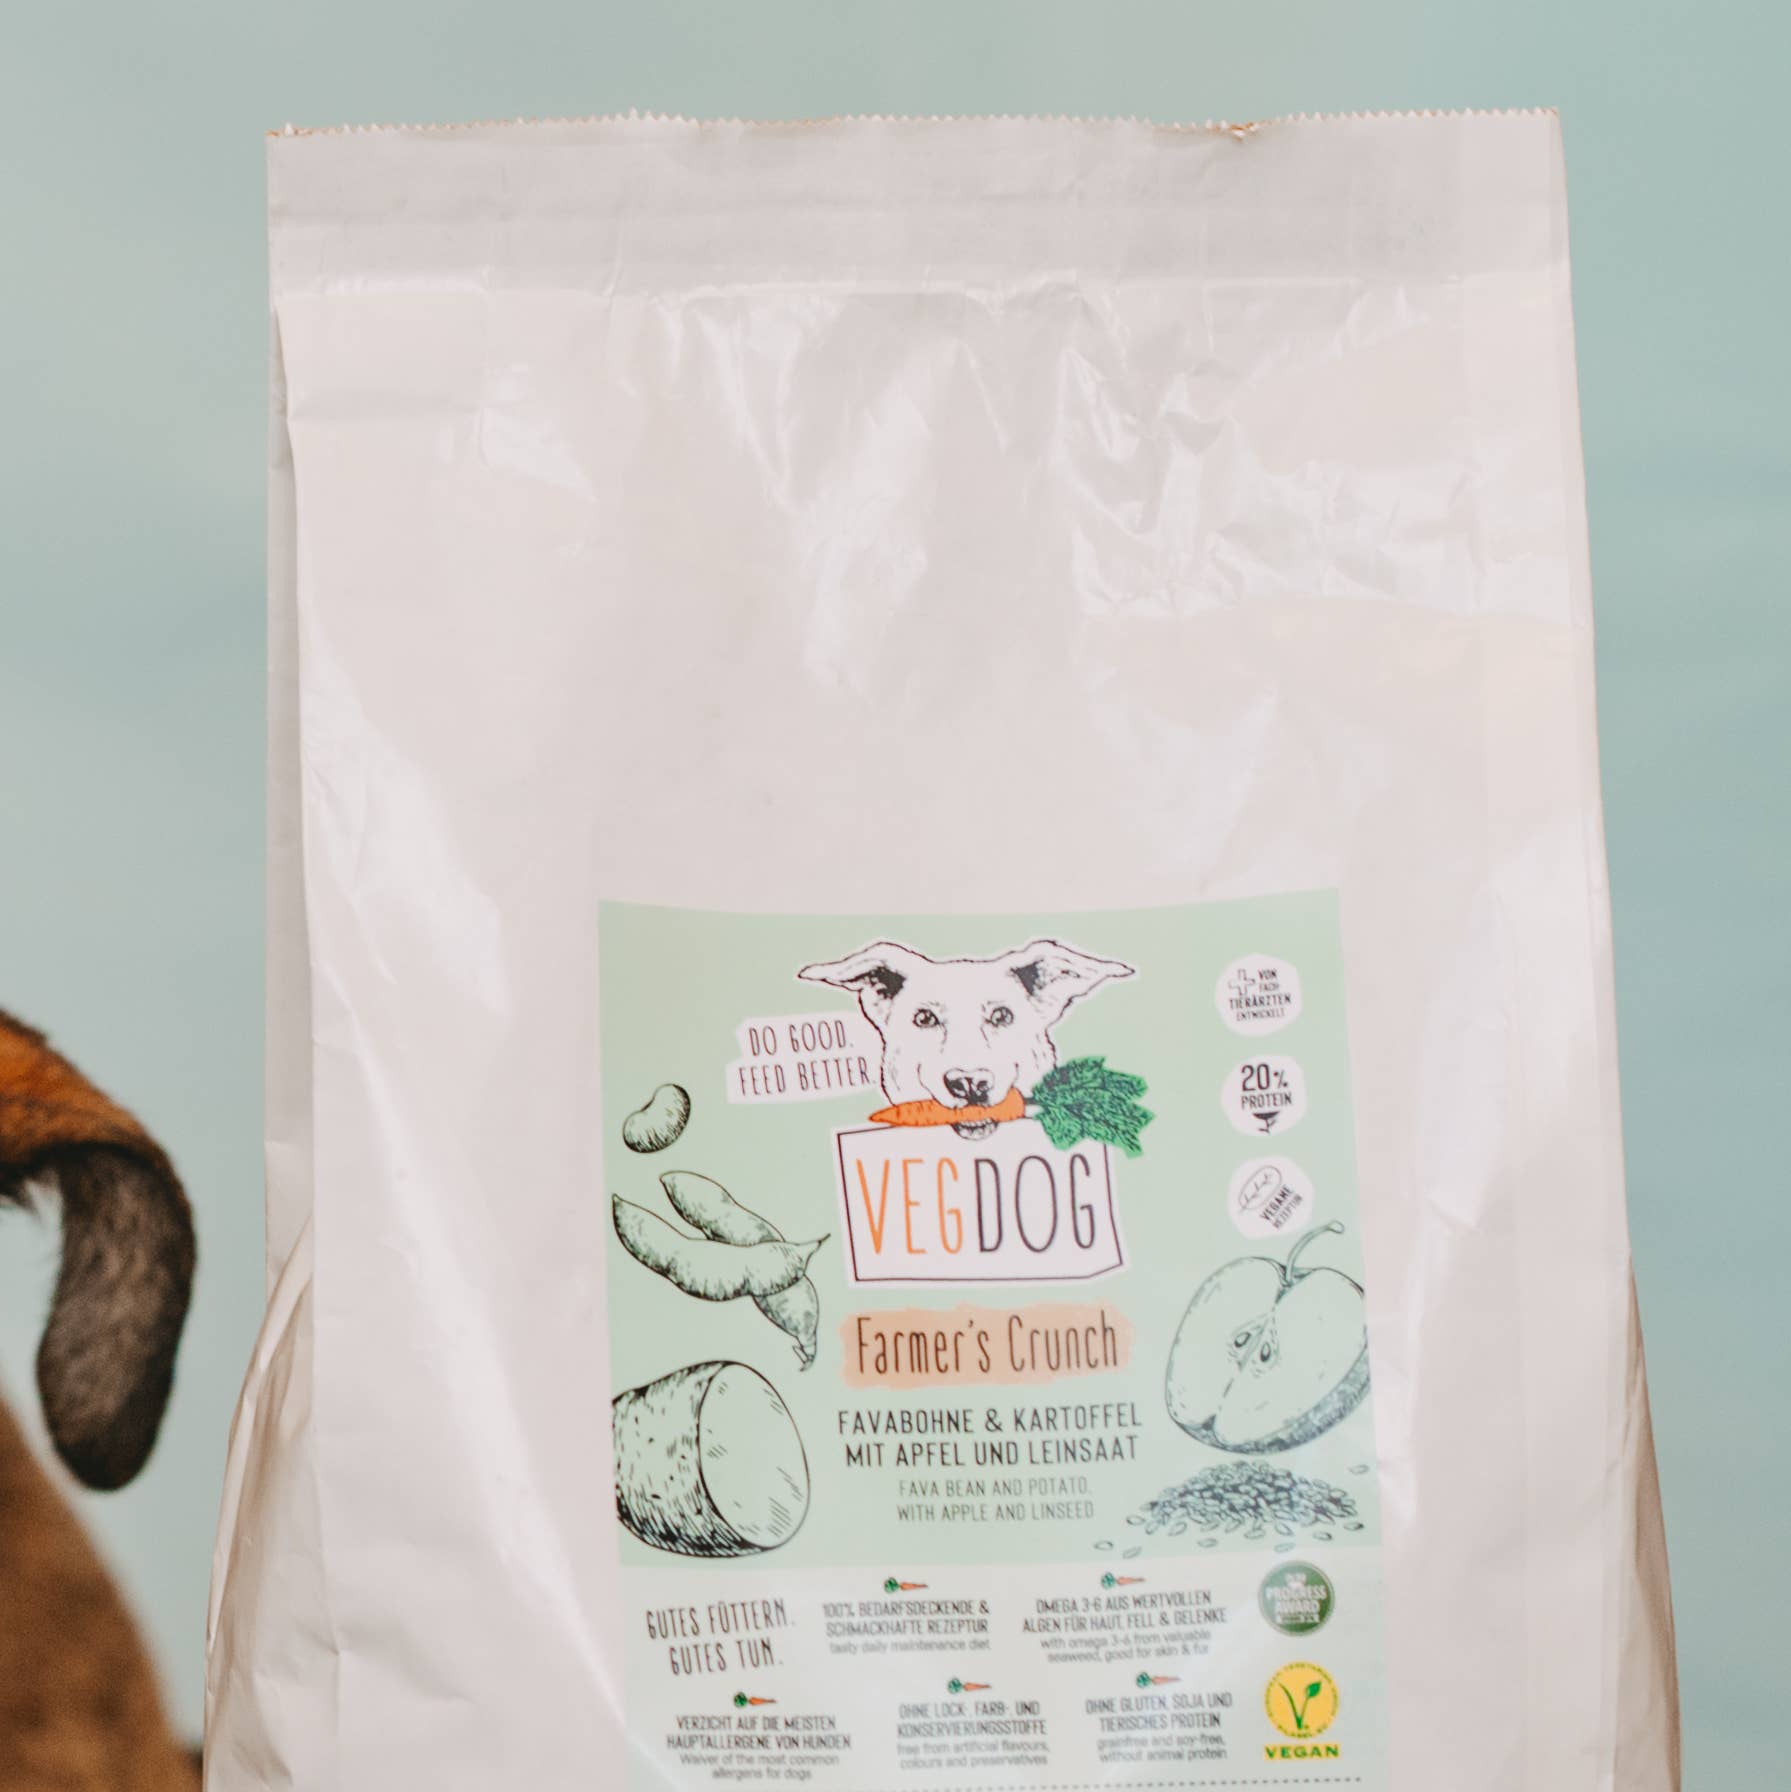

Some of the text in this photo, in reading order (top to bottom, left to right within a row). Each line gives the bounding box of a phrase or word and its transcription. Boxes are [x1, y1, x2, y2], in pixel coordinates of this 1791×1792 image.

[749, 1020, 855, 1056] DO GOOD.
[739, 1056, 876, 1096] FEED BETTER.
[1241, 1092, 1293, 1110] PROTEIN
[856, 1154, 1095, 1255] VEGDOG
[857, 1309, 1118, 1375] Farmer's Crunch
[837, 1402, 1142, 1435] FAVABOHNE & KARTOFFEL
[845, 1435, 1139, 1467] MIT APFEL UND LEINSAAT
[898, 1480, 939, 1497] FAVA
[947, 1479, 985, 1497] BEAN
[993, 1479, 1023, 1496] AND
[897, 1500, 1094, 1521] WITH APPLE AND LINSEED
[823, 1599, 990, 1618] 100% BEDARFSDECKENDE &
[1036, 1597, 1078, 1614] OMEGA
[1105, 1595, 1128, 1611] AUS
[1132, 1590, 1212, 1609] WERTVOLLEN
[646, 1606, 700, 1640] GUTES
[826, 1618, 989, 1637] SCHMACKHAFTE REZEPTUR
[1022, 1616, 1061, 1633] ALGEN
[1064, 1615, 1087, 1632] FÜR
[1127, 1612, 1153, 1629] FELL
[1159, 1610, 1170, 1626] &
[1174, 1606, 1227, 1625] GELENKE
[862, 1640, 887, 1654] daily
[890, 1639, 966, 1652] maintenance
[1040, 1637, 1065, 1650] with
[1068, 1637, 1107, 1651] omega
[1133, 1632, 1161, 1645] from
[669, 1642, 727, 1676] GUTES
[898, 1702, 931, 1719] OHNE
[1015, 1700, 1040, 1716] UND
[1084, 1697, 1115, 1714] OHNE
[1171, 1693, 1205, 1710] SOJA
[1207, 1691, 1233, 1708] UND
[675, 1714, 836, 1731] VERZICHT AUF DIE MEISTEN
[1099, 1711, 1221, 1732] TIERISCHES PROTEIN
[667, 1733, 852, 1750] HAUPTALLERGENE VON HUNDEN
[1151, 1734, 1173, 1747] and
[735, 1753, 754, 1764] the
[758, 1753, 785, 1764] most
[789, 1754, 840, 1764] common
[946, 1756, 968, 1768] and
[1265, 1745, 1339, 1760] VEGAN
[766, 1766, 780, 1779] for
